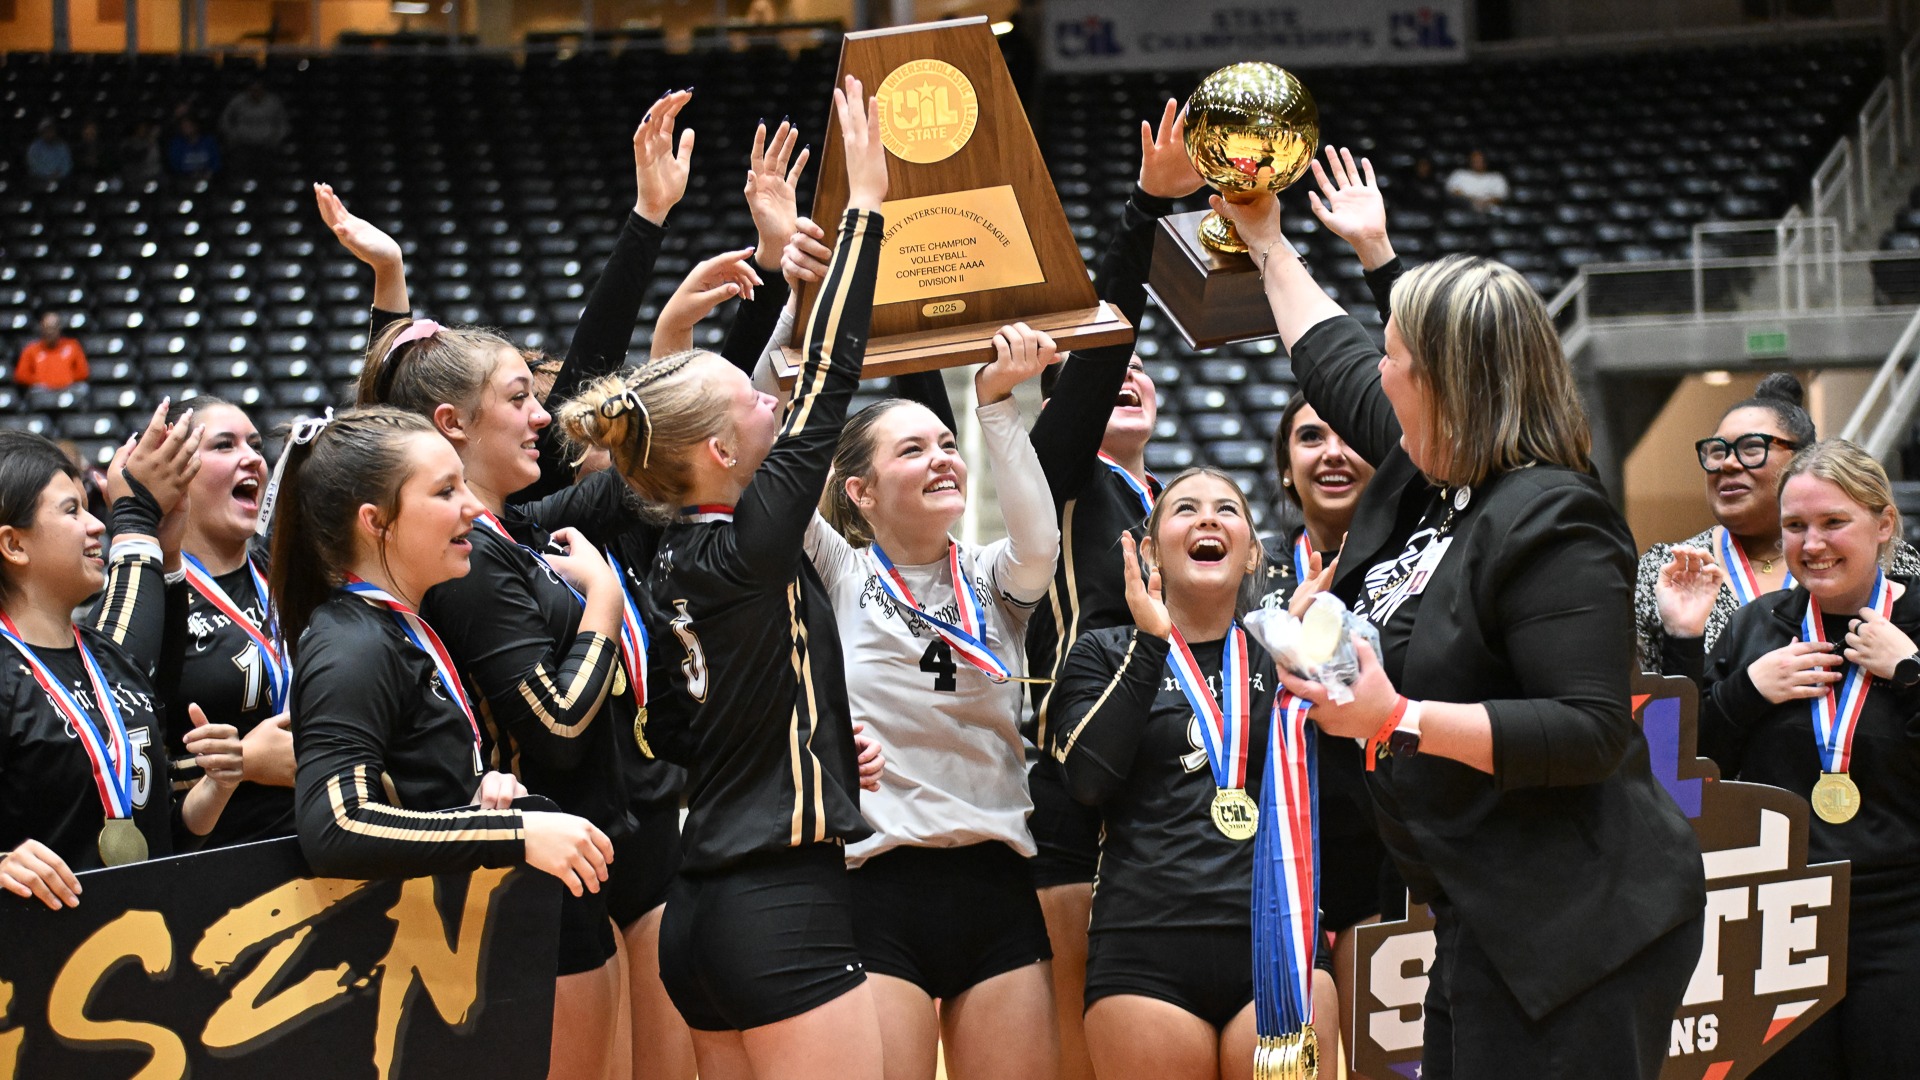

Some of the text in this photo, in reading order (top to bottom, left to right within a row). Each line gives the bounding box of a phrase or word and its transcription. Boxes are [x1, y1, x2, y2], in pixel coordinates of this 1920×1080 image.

[885, 61, 973, 96] INTERSCHOLASTIC
[953, 105, 977, 148] LEAGUE
[906, 126, 948, 142] STATE
[904, 206, 984, 225] INTERSCHOLASTIC
[982, 219, 1011, 248] LEAGUE
[899, 237, 977, 255] STATE CHAMPION
[910, 250, 968, 265] VOLLEYBALL
[895, 259, 985, 279] CONFERENCE AAAA
[918, 274, 965, 288] DIVISION II
[932, 302, 957, 315] 2025
[919, 639, 957, 692] 4
